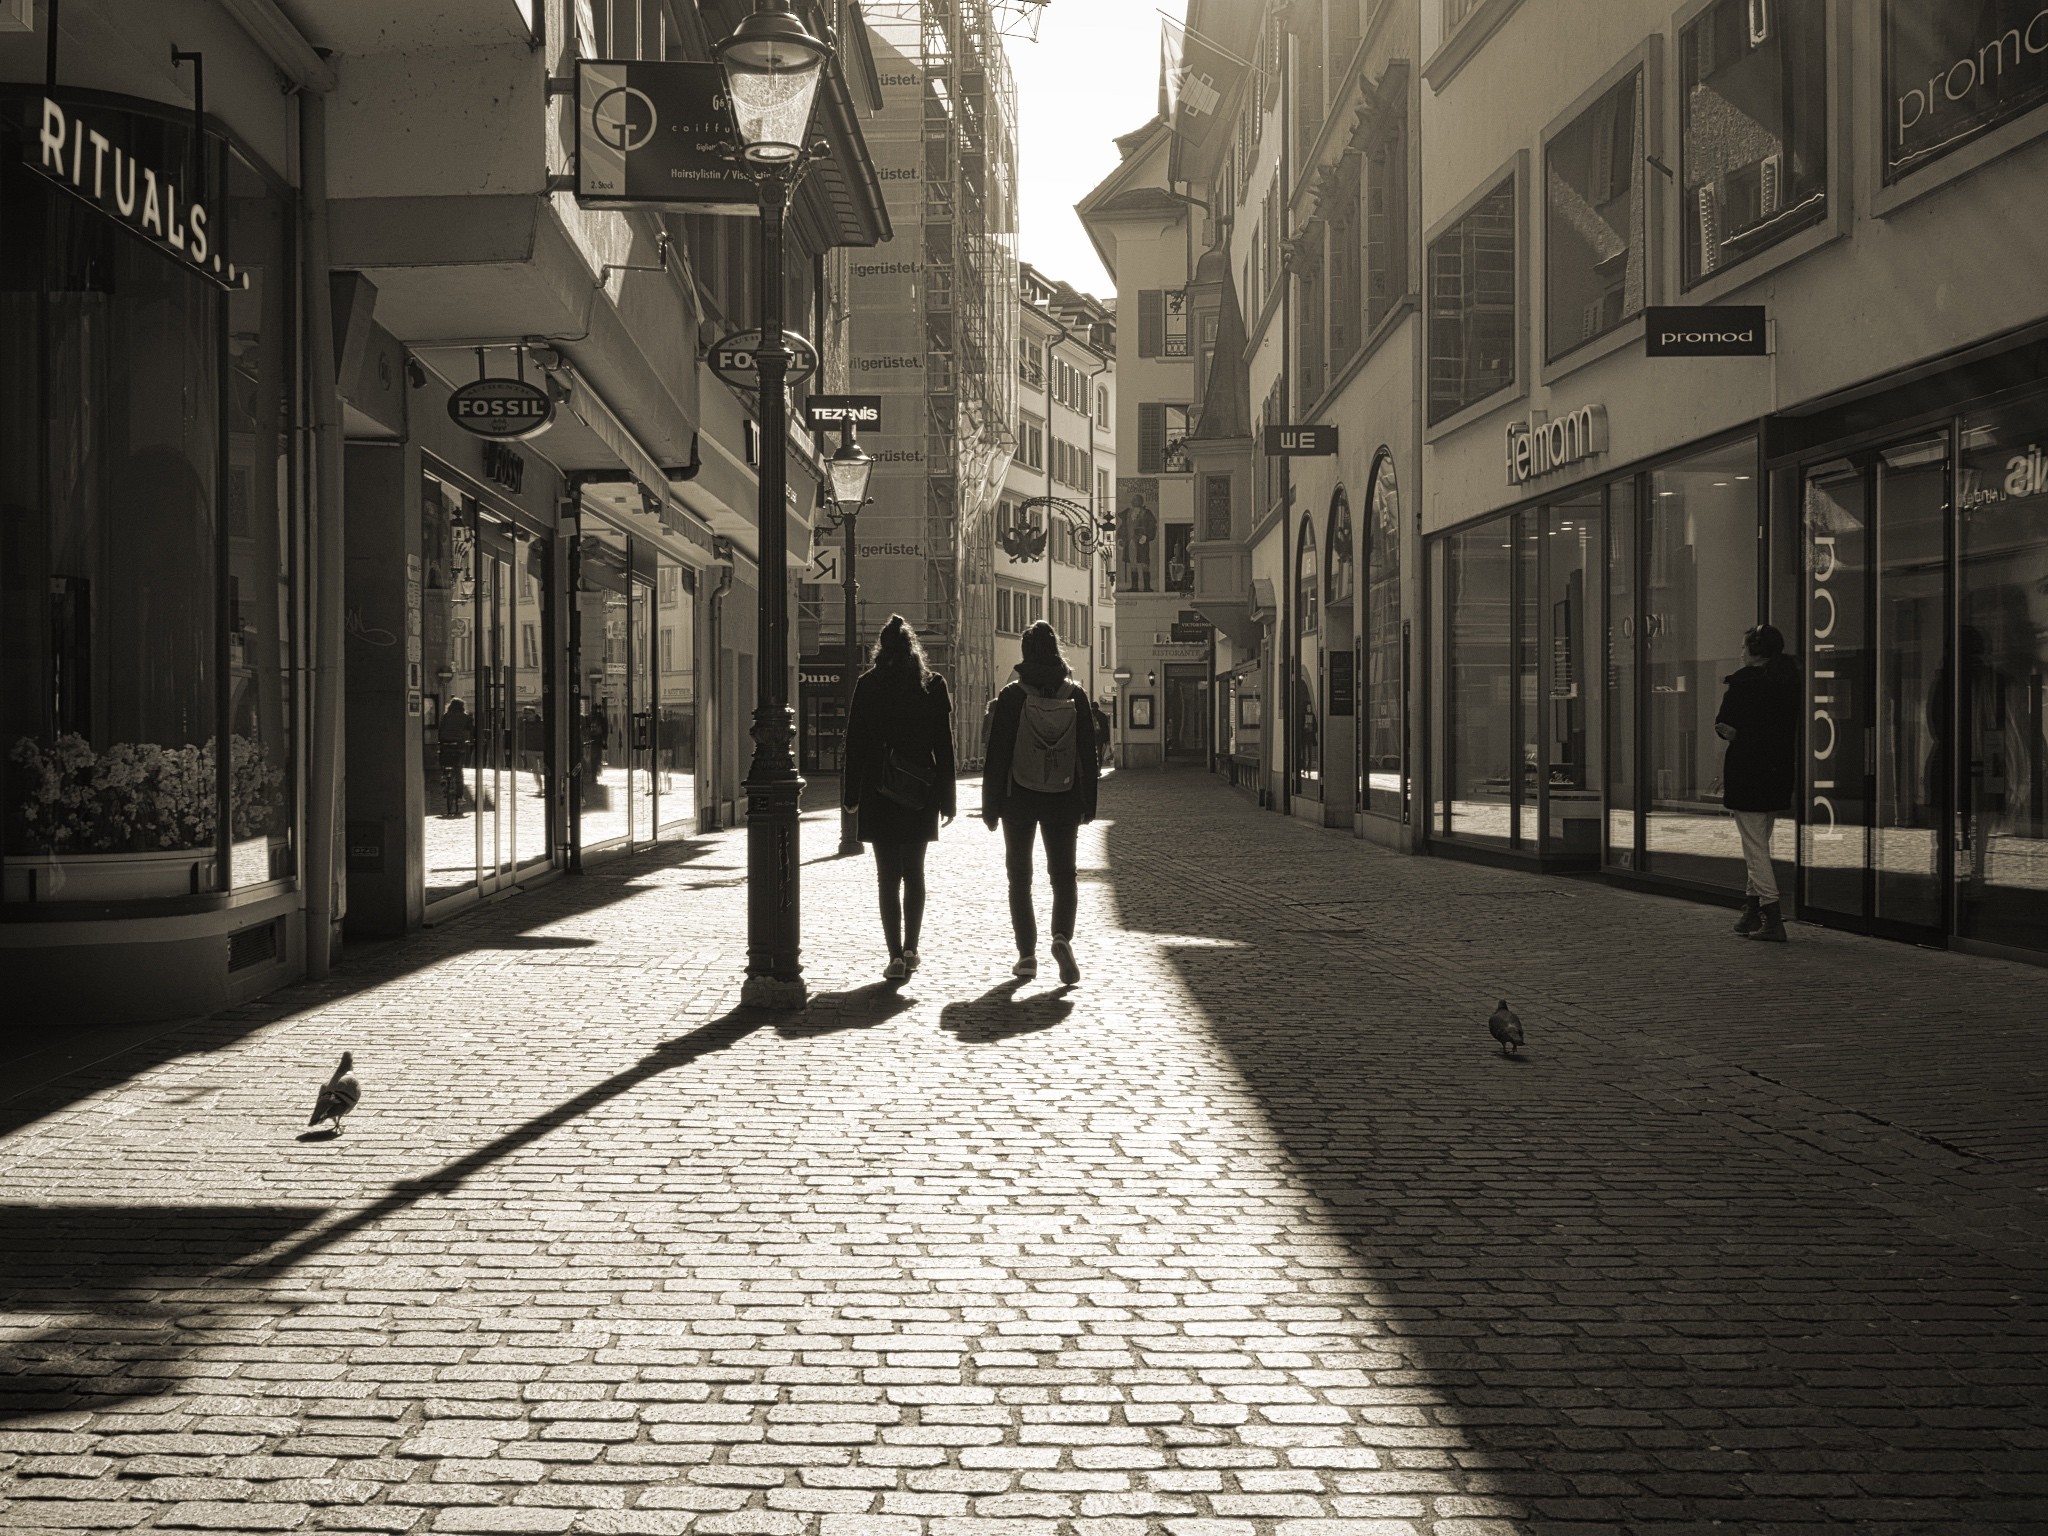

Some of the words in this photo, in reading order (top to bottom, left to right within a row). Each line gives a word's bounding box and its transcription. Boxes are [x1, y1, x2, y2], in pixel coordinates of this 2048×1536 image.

[671, 168, 721, 181] Hairstylistin
[591, 181, 598, 190] 2.
[599, 181, 615, 190] Stock
[1661, 329, 1753, 345] promod
[458, 400, 544, 415] FOSSIL
[1505, 404, 1604, 486] fielmann
[798, 672, 840, 683] Dune
